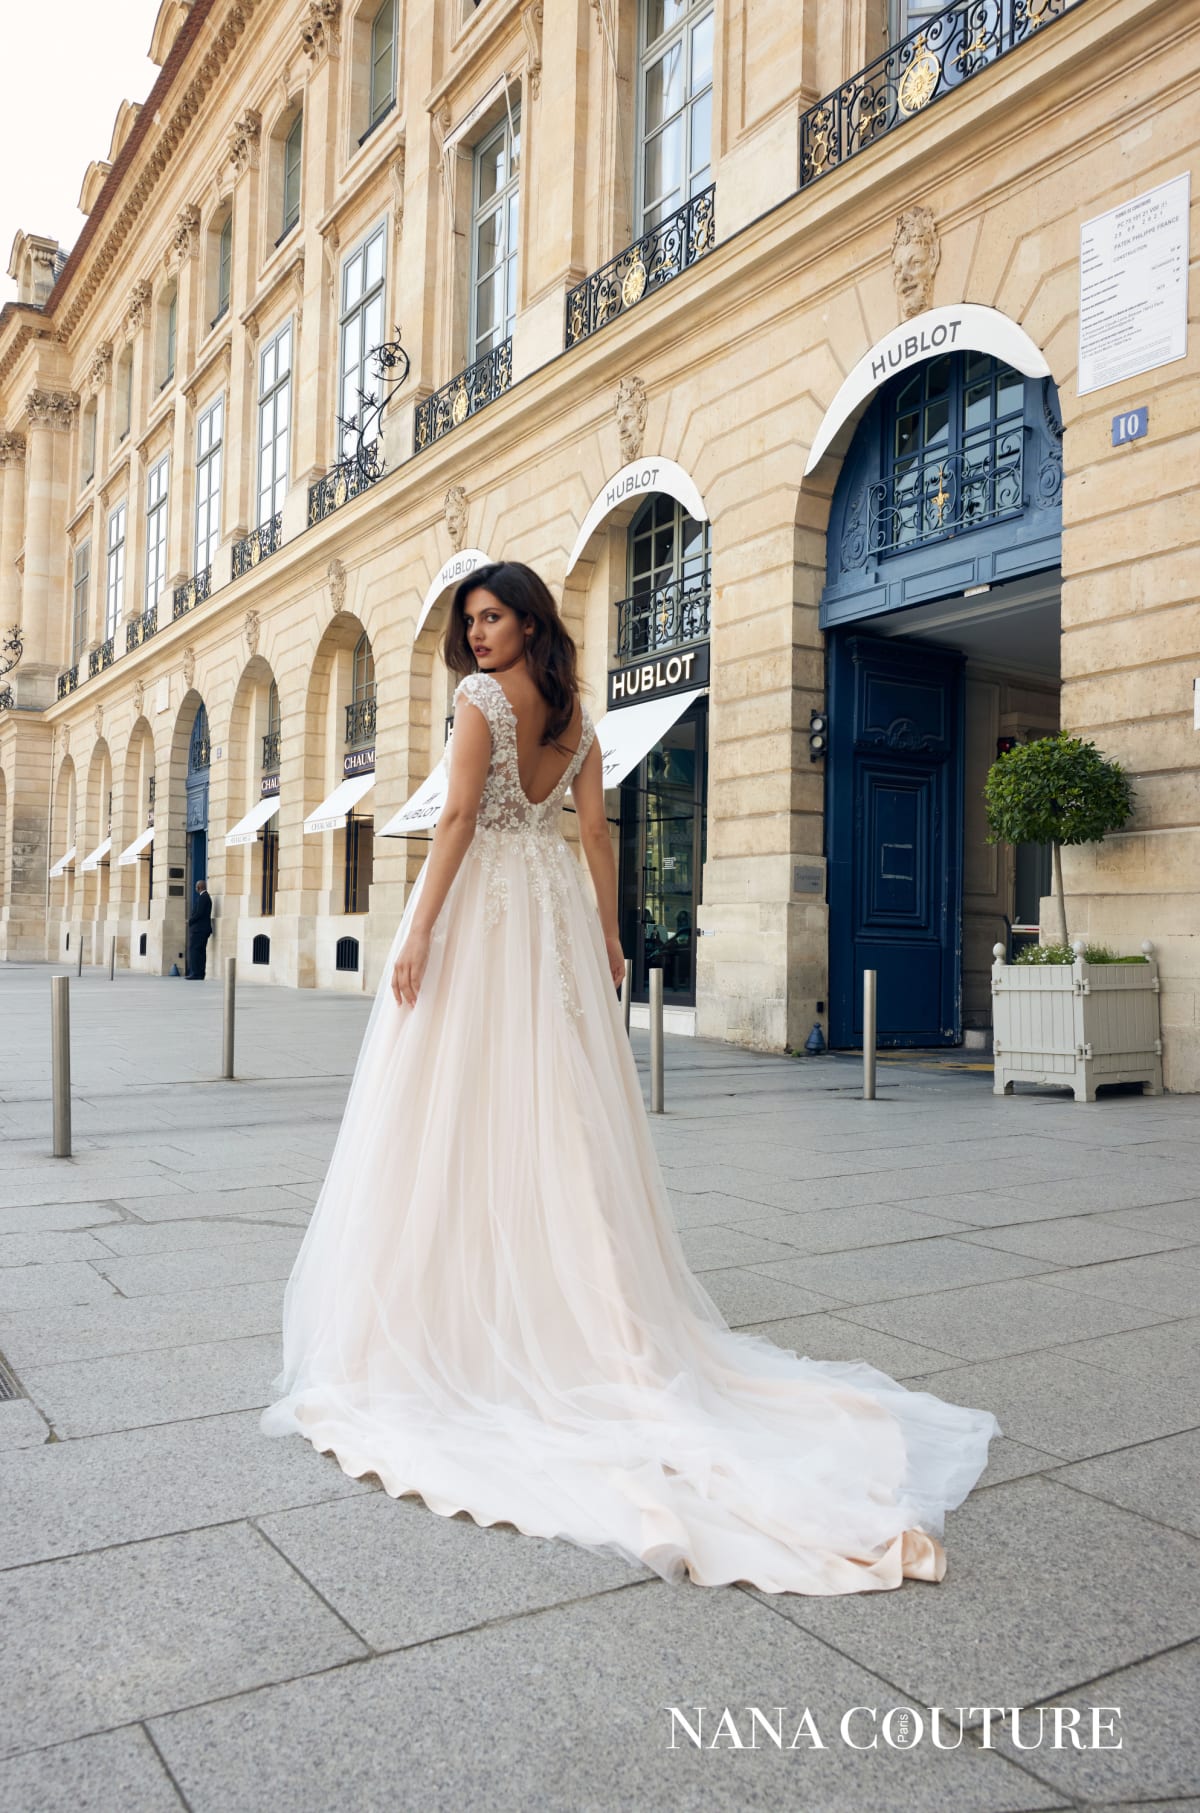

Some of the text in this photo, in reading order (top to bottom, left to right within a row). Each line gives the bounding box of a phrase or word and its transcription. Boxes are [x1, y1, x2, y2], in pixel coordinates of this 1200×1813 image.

[1157, 215, 1179, 230] FRANCE
[871, 320, 962, 380] HUBLOT
[1119, 413, 1139, 440] 10
[606, 468, 660, 507] HUBLOT
[441, 557, 478, 585] HUBLOT
[612, 652, 695, 700] HUBLOT
[344, 750, 376, 770] CHAUM
[261, 777, 280, 791] CHAU
